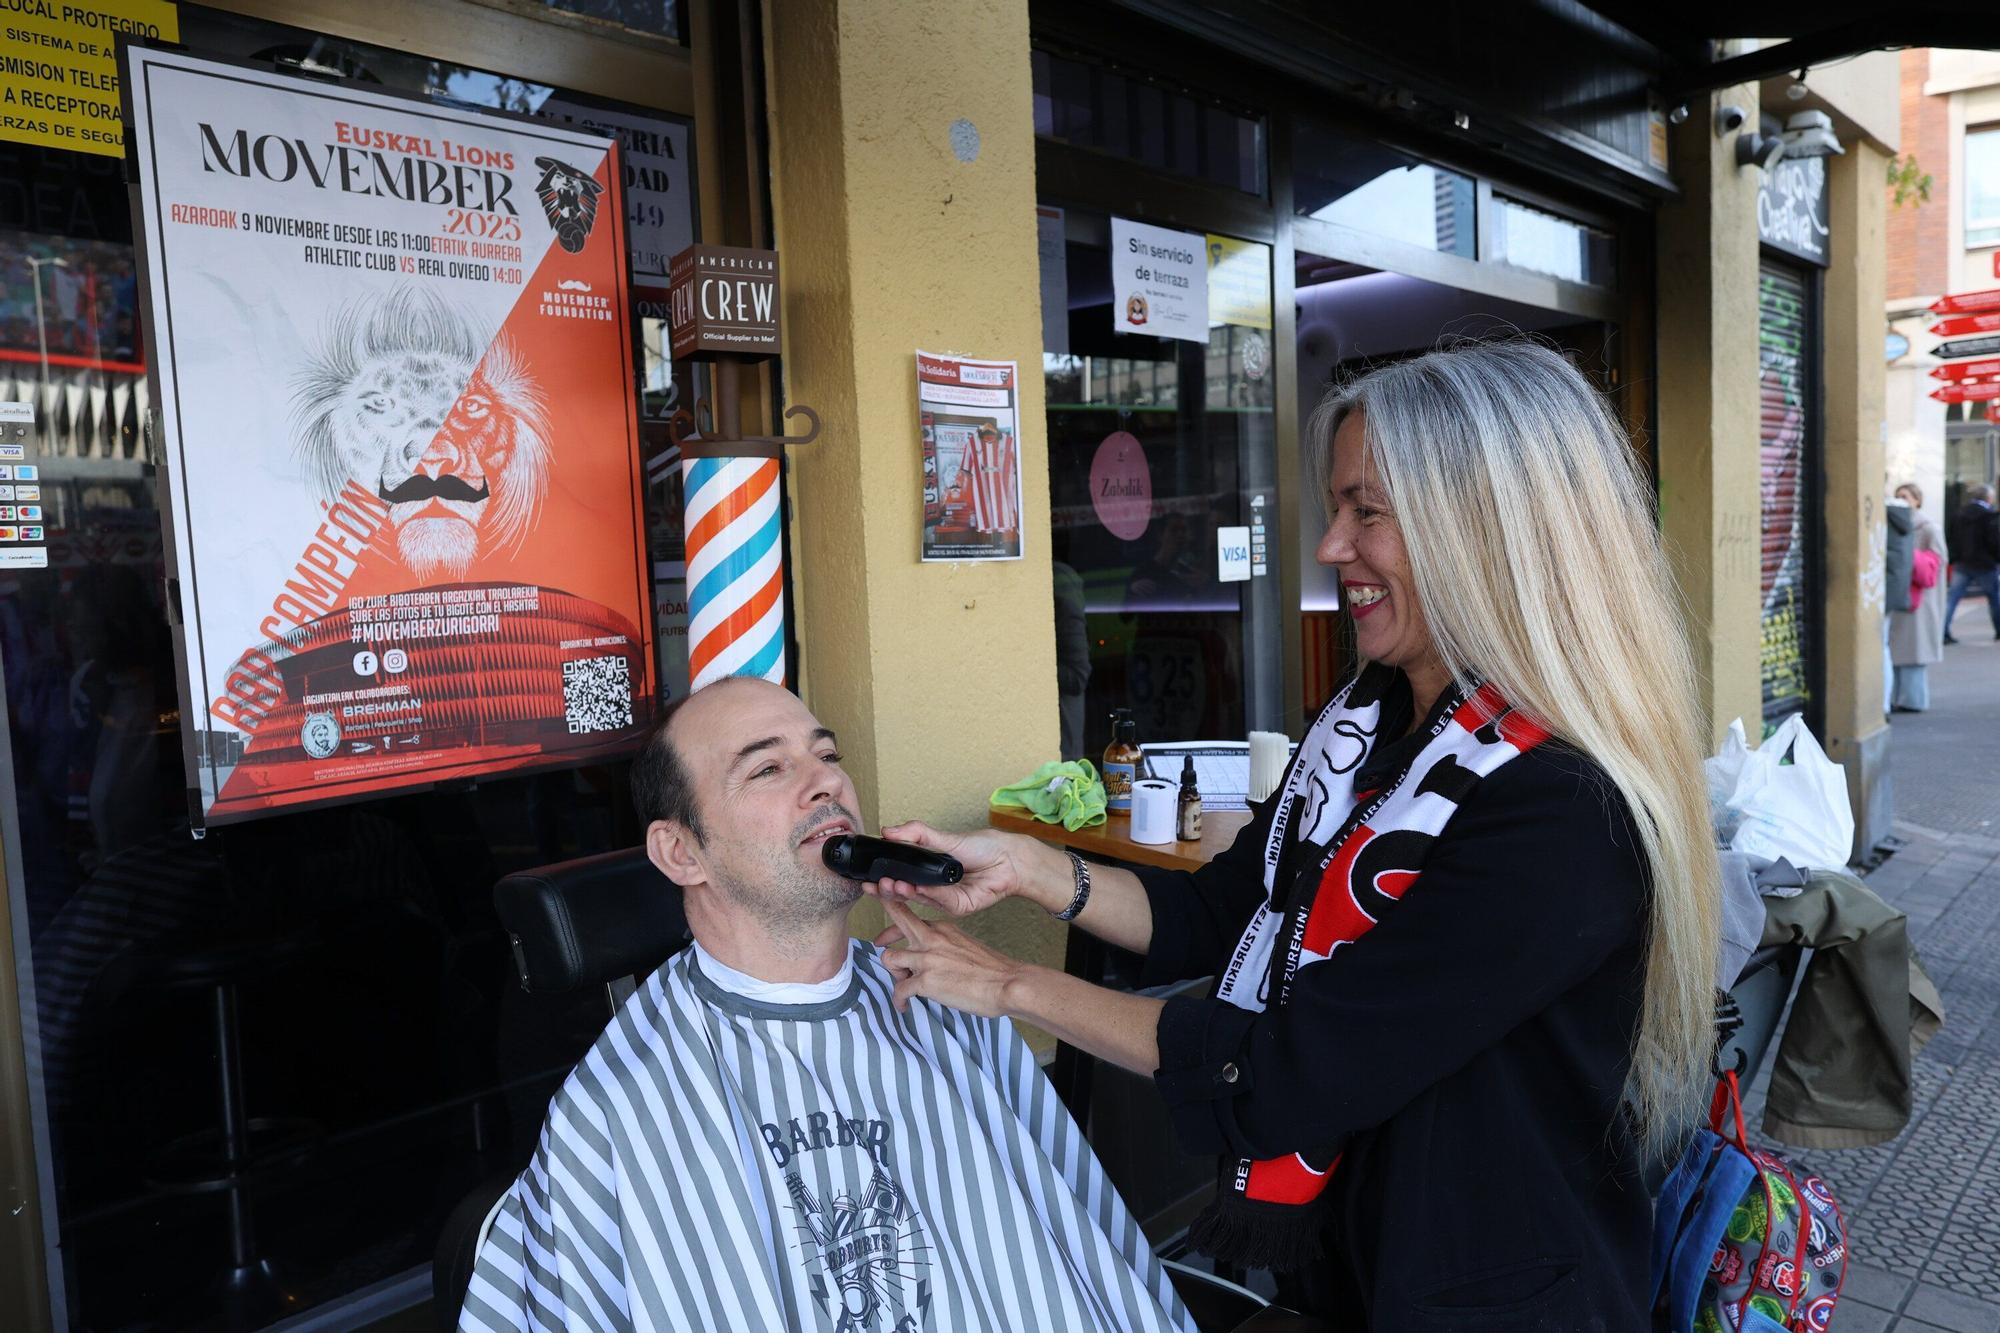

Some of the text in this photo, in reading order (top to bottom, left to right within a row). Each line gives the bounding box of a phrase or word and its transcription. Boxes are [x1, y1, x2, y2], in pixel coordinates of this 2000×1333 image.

[62, 6, 159, 40] PROTEGIDO
[6, 28, 74, 51] SISTEMA
[78, 42, 98, 56] DE
[4, 87, 122, 121] A RECEPTORA
[54, 125, 76, 137] DE
[335, 121, 515, 171] EUSKAL LIONS
[197, 122, 519, 216] MOVEMBER
[172, 203, 237, 229] AZAROAK
[242, 213, 251, 230] 9
[255, 214, 330, 240] NOVIEMBRE
[334, 224, 372, 245] DESDE
[376, 229, 398, 248] LAS
[471, 242, 522, 263] AURRERA
[305, 245, 522, 284] ATHLETIC CLUB VS REAL OVIEDO 14:00
[699, 256, 773, 270] AMERICAN
[1129, 238, 1193, 265] Sin servicio
[1135, 266, 1189, 289] de terraza
[539, 304, 612, 321] FOUNDATION
[543, 291, 608, 308] MOVEMBER
[703, 332, 725, 340] Official
[727, 334, 751, 342] Supplier
[1101, 478, 1143, 497] Zabalik
[259, 478, 390, 655] CAMPEÓN
[1222, 547, 1248, 562] VISA
[348, 586, 539, 610] IGO ZURE BIBOTEAREN ARGAZKIAK TRAOLAREKIN
[350, 598, 539, 623] SUBE LAS FOTOS DE TU BIGOTE CON EL HASHTAG
[351, 614, 499, 643] #MOVEMBERZURIGORRI
[303, 691, 354, 706] LAGUNTZAILEAK
[343, 699, 421, 717] BREHMAN
[1431, 700, 1460, 736] BETI
[1284, 905, 1310, 982] ZUREKIN!
[759, 1111, 891, 1168] BARBER
[1814, 1245, 1846, 1268] HERO
